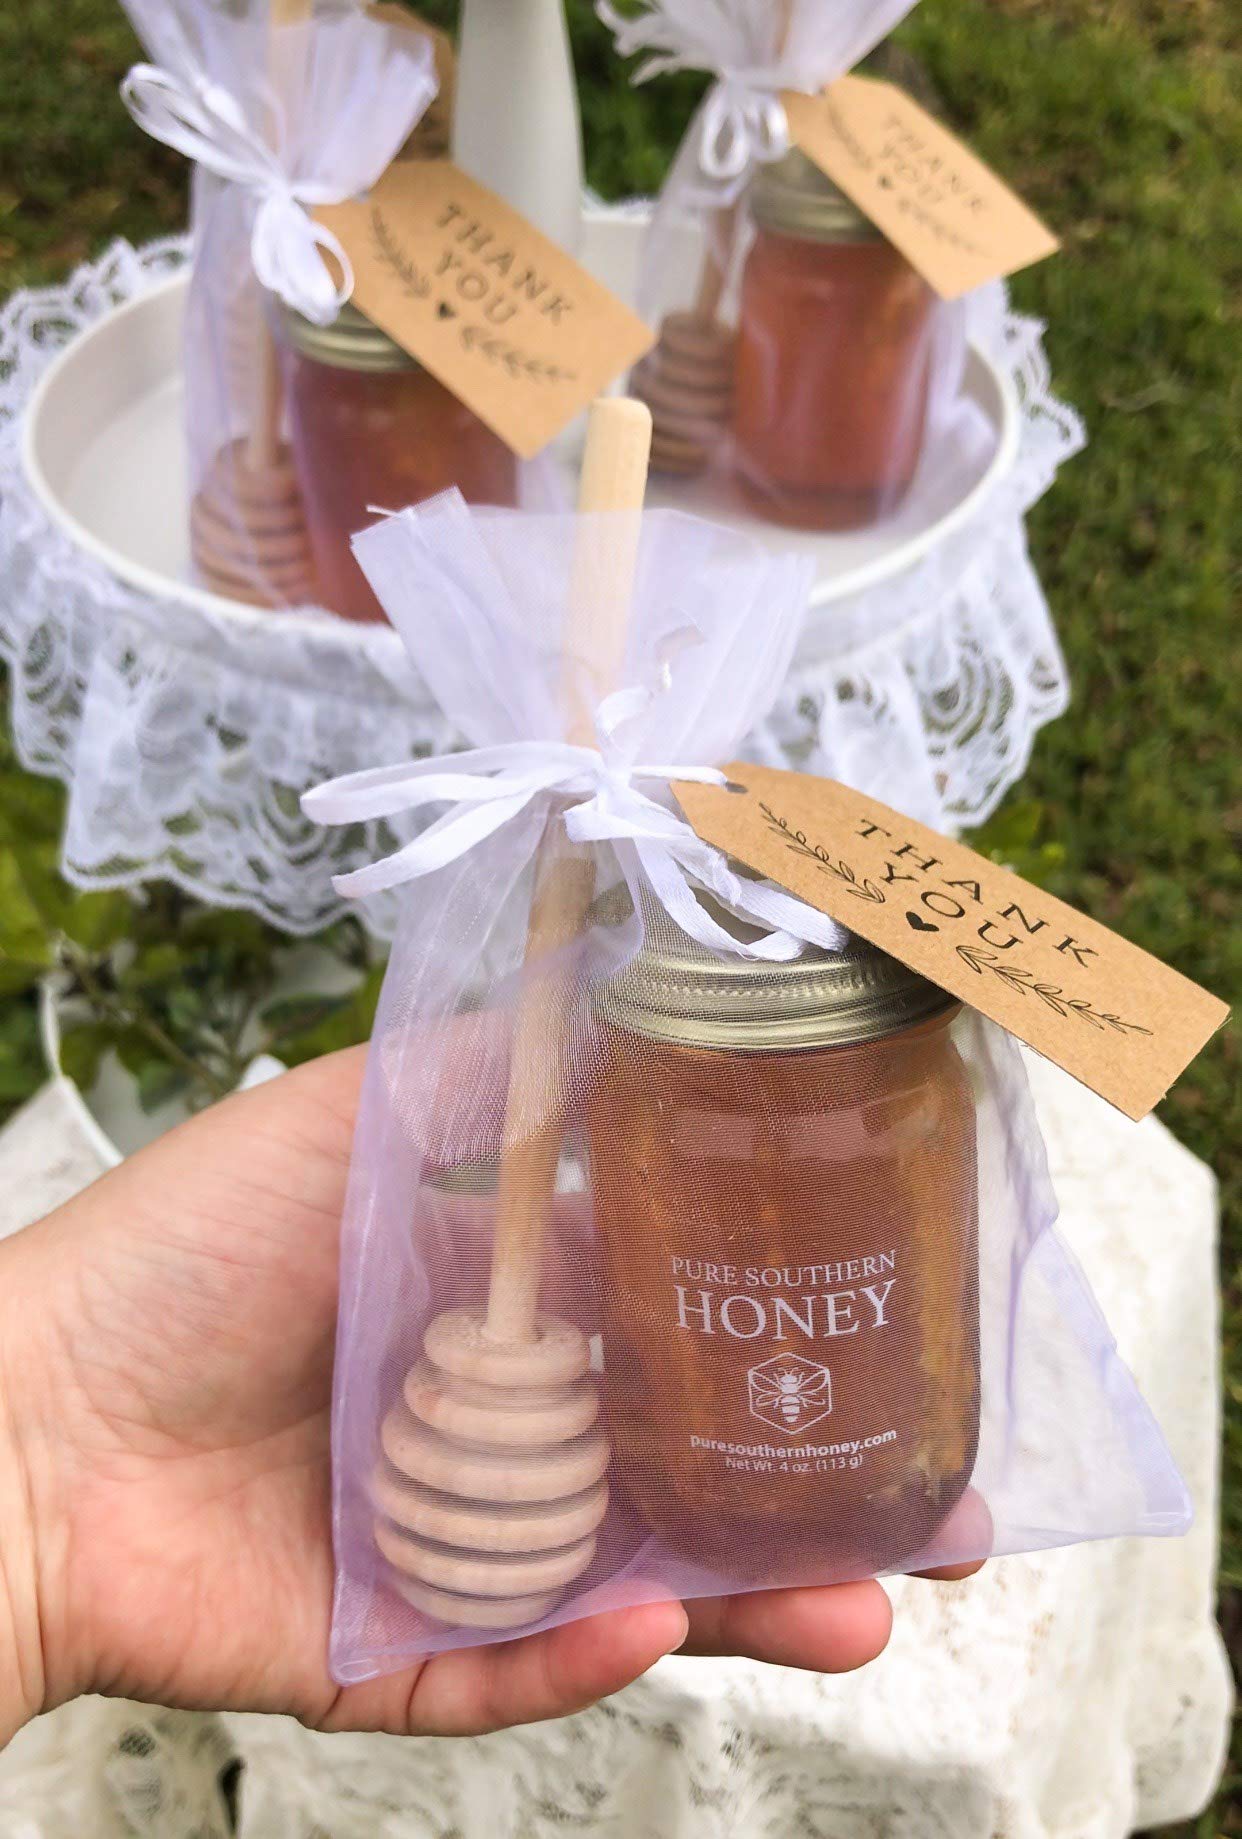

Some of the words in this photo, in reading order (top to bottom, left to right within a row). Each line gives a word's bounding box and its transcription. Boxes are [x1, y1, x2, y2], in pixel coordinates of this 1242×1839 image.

[435, 250, 518, 325] YOU
[436, 202, 574, 326] THANK
[855, 818, 1100, 969] THANK
[880, 861, 1025, 950] YOU
[671, 1256, 738, 1286] PURE
[745, 1249, 897, 1287] SOUTHERN
[673, 1279, 897, 1340] HONEY
[689, 1429, 898, 1458] puresouthernhoney.com
[725, 1457, 750, 1471] Net
[753, 1460, 776, 1472] Wt.
[778, 1461, 788, 1472] 4
[792, 1463, 812, 1473] oz.
[815, 1459, 846, 1472] (113
[849, 1454, 863, 1469] g)
